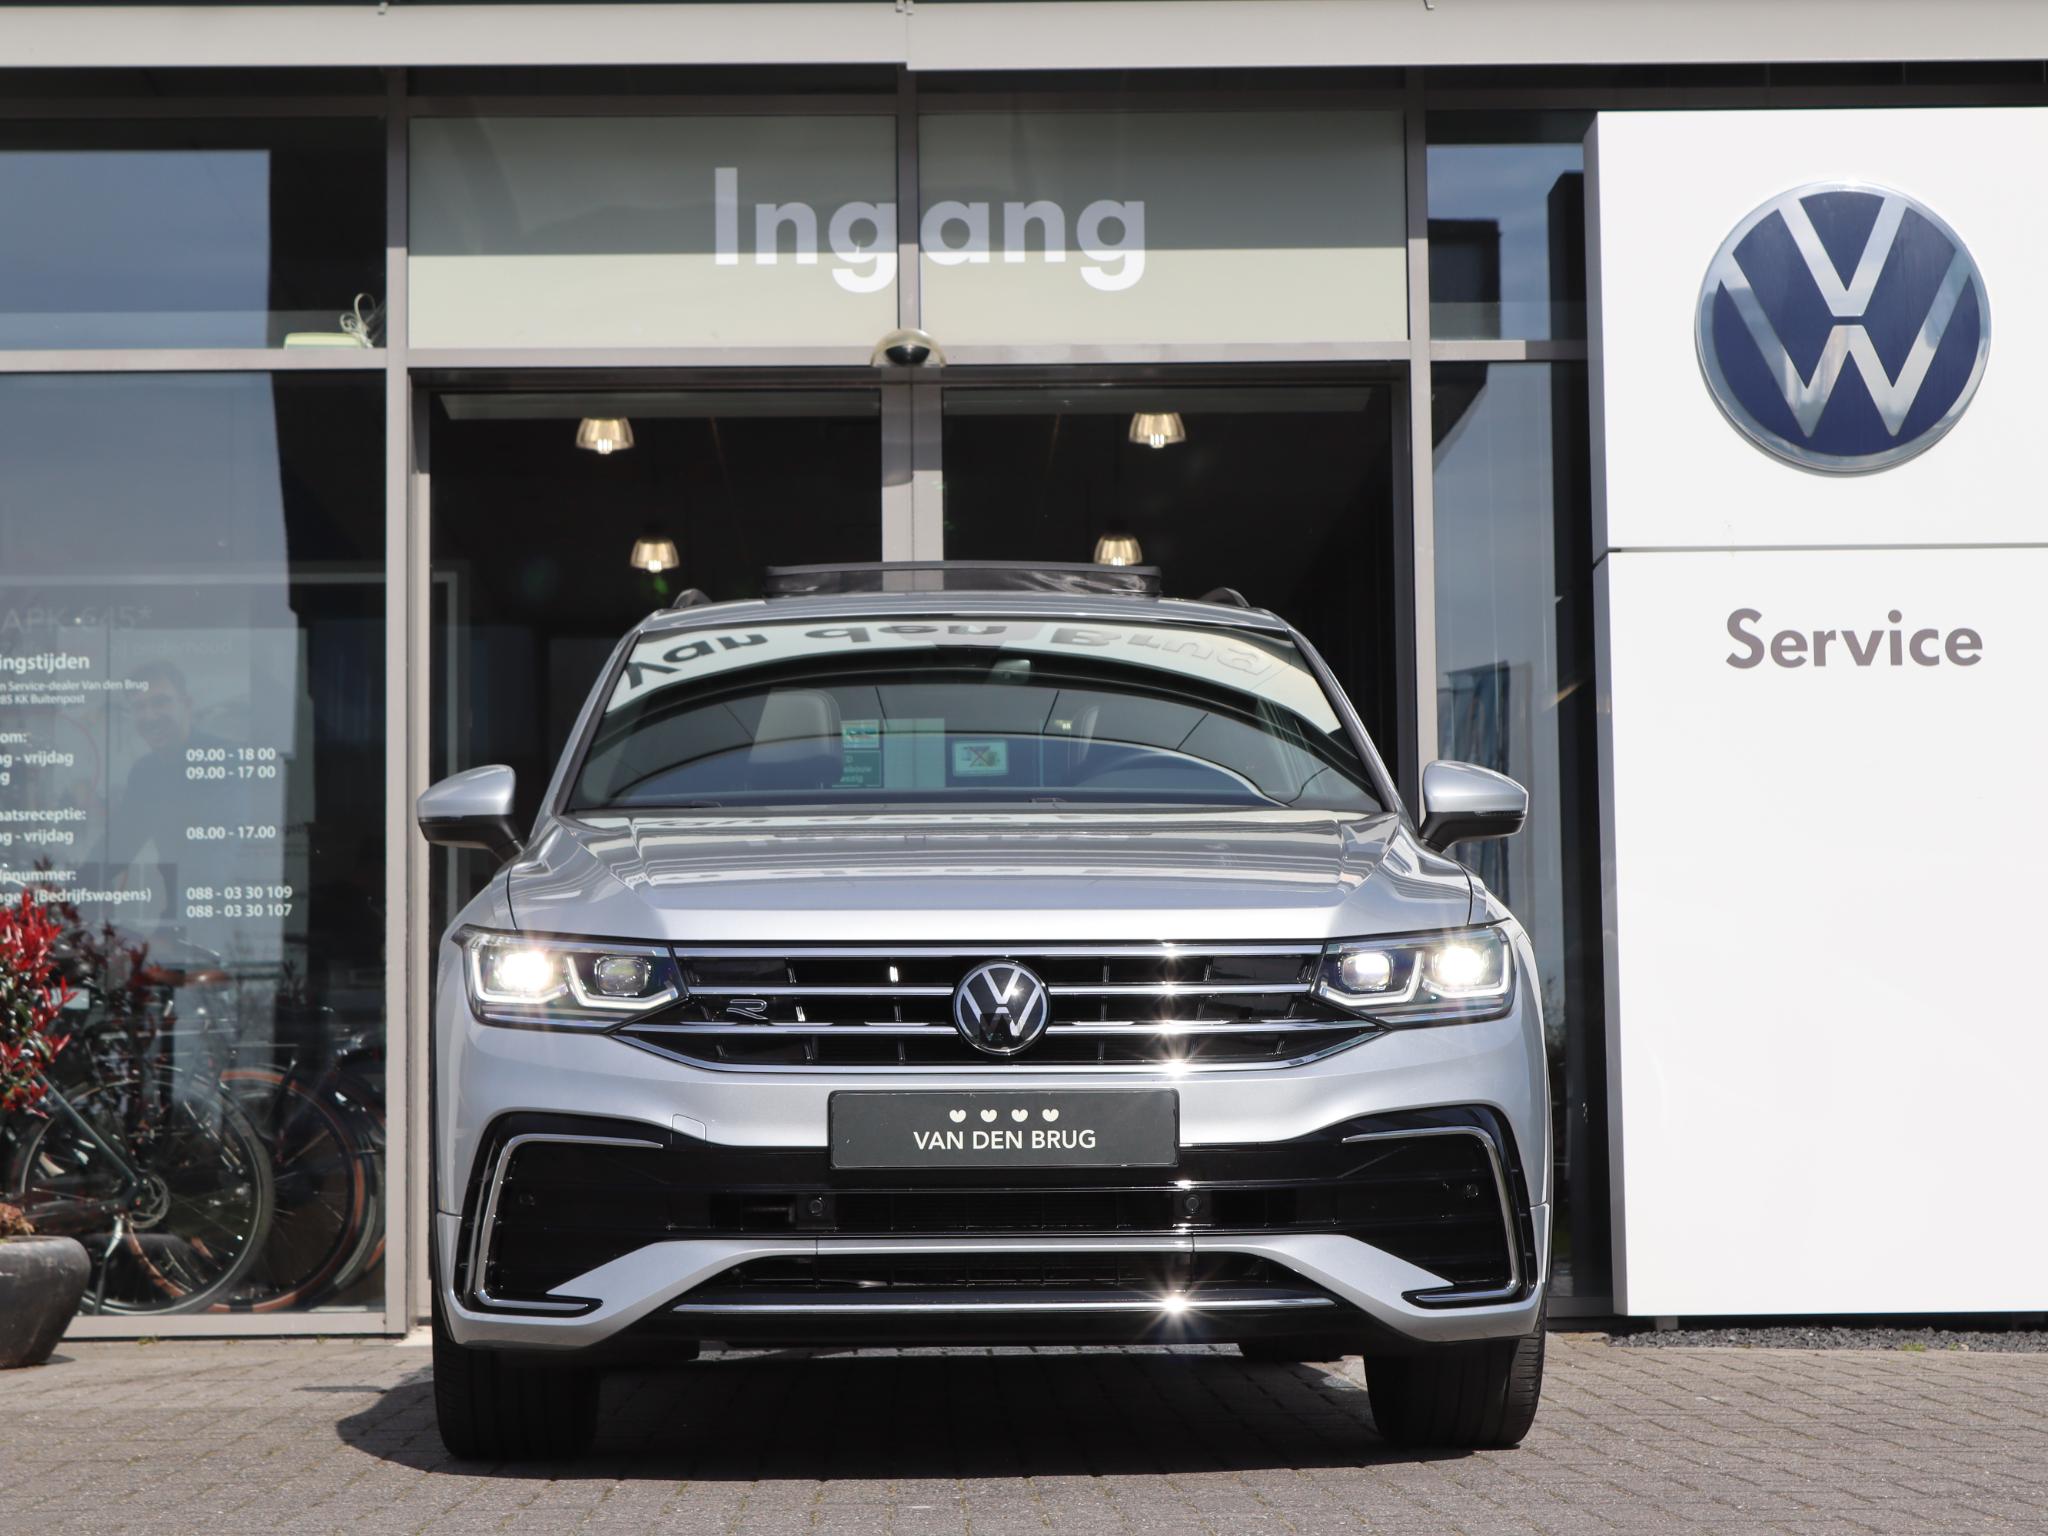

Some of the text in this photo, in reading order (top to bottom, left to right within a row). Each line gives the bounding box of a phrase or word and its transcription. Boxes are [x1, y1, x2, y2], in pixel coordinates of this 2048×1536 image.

[715, 167, 1145, 292] Ingang
[1725, 607, 1984, 669] Service
[8, 680, 80, 692] Service-dealer
[82, 680, 101, 690] Van
[103, 680, 123, 690] den
[124, 679, 149, 692] Brug
[30, 693, 85, 705] Buitenpost
[23, 749, 75, 767] vrijdag
[186, 748, 226, 762] 09.00
[186, 766, 226, 779] 09.00
[24, 828, 74, 845] vrijdag
[186, 826, 226, 840] 08.00
[238, 825, 276, 839] 17.00
[186, 887, 213, 900] 088
[224, 887, 242, 899] 03
[245, 886, 263, 899] 30
[267, 885, 293, 899] 109
[186, 905, 213, 918] 088
[224, 904, 242, 917] 03
[245, 904, 263, 917] 30
[267, 903, 292, 917] 107
[913, 1129, 1096, 1150] VAN DEN BRUG
